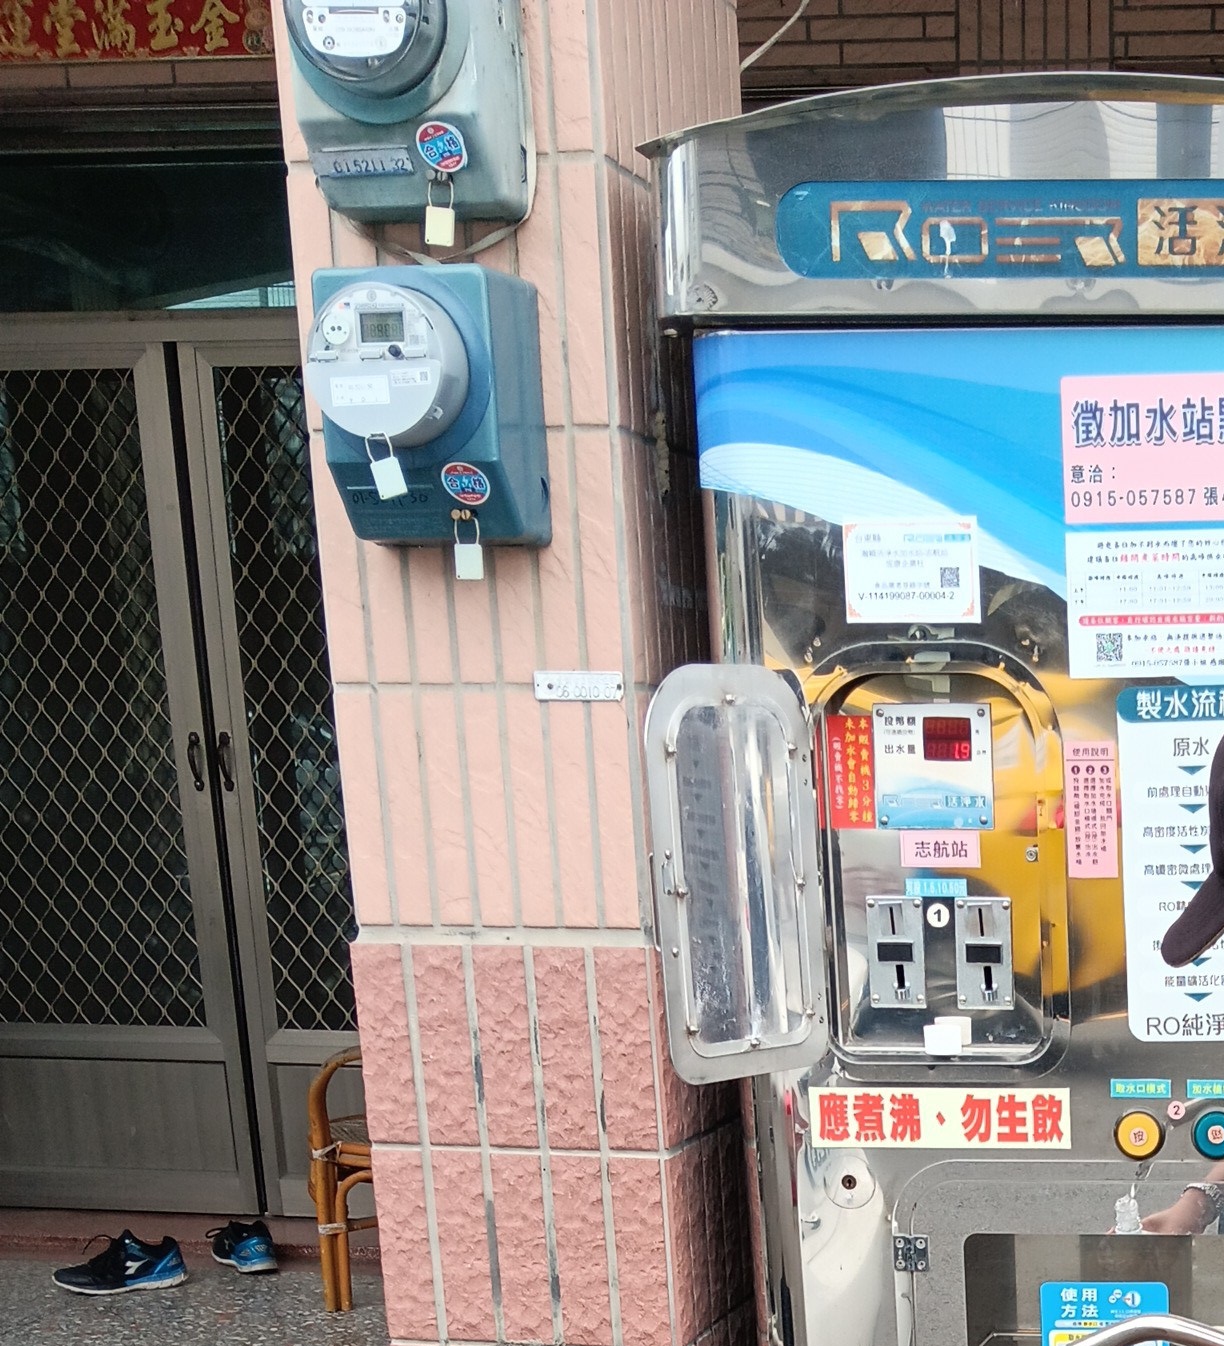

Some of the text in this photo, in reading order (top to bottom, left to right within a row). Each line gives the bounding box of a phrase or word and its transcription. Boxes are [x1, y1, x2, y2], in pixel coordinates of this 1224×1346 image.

[1071, 489, 1196, 507] 0915-057587
[885, 744, 916, 754] 出水量
[1173, 737, 1210, 757] 原水
[915, 841, 968, 859] 志航站
[933, 909, 942, 922] 1
[1173, 1105, 1180, 1115] 2
[1061, 1287, 1098, 1302] 使用
[1061, 1304, 1098, 1318] 方法
